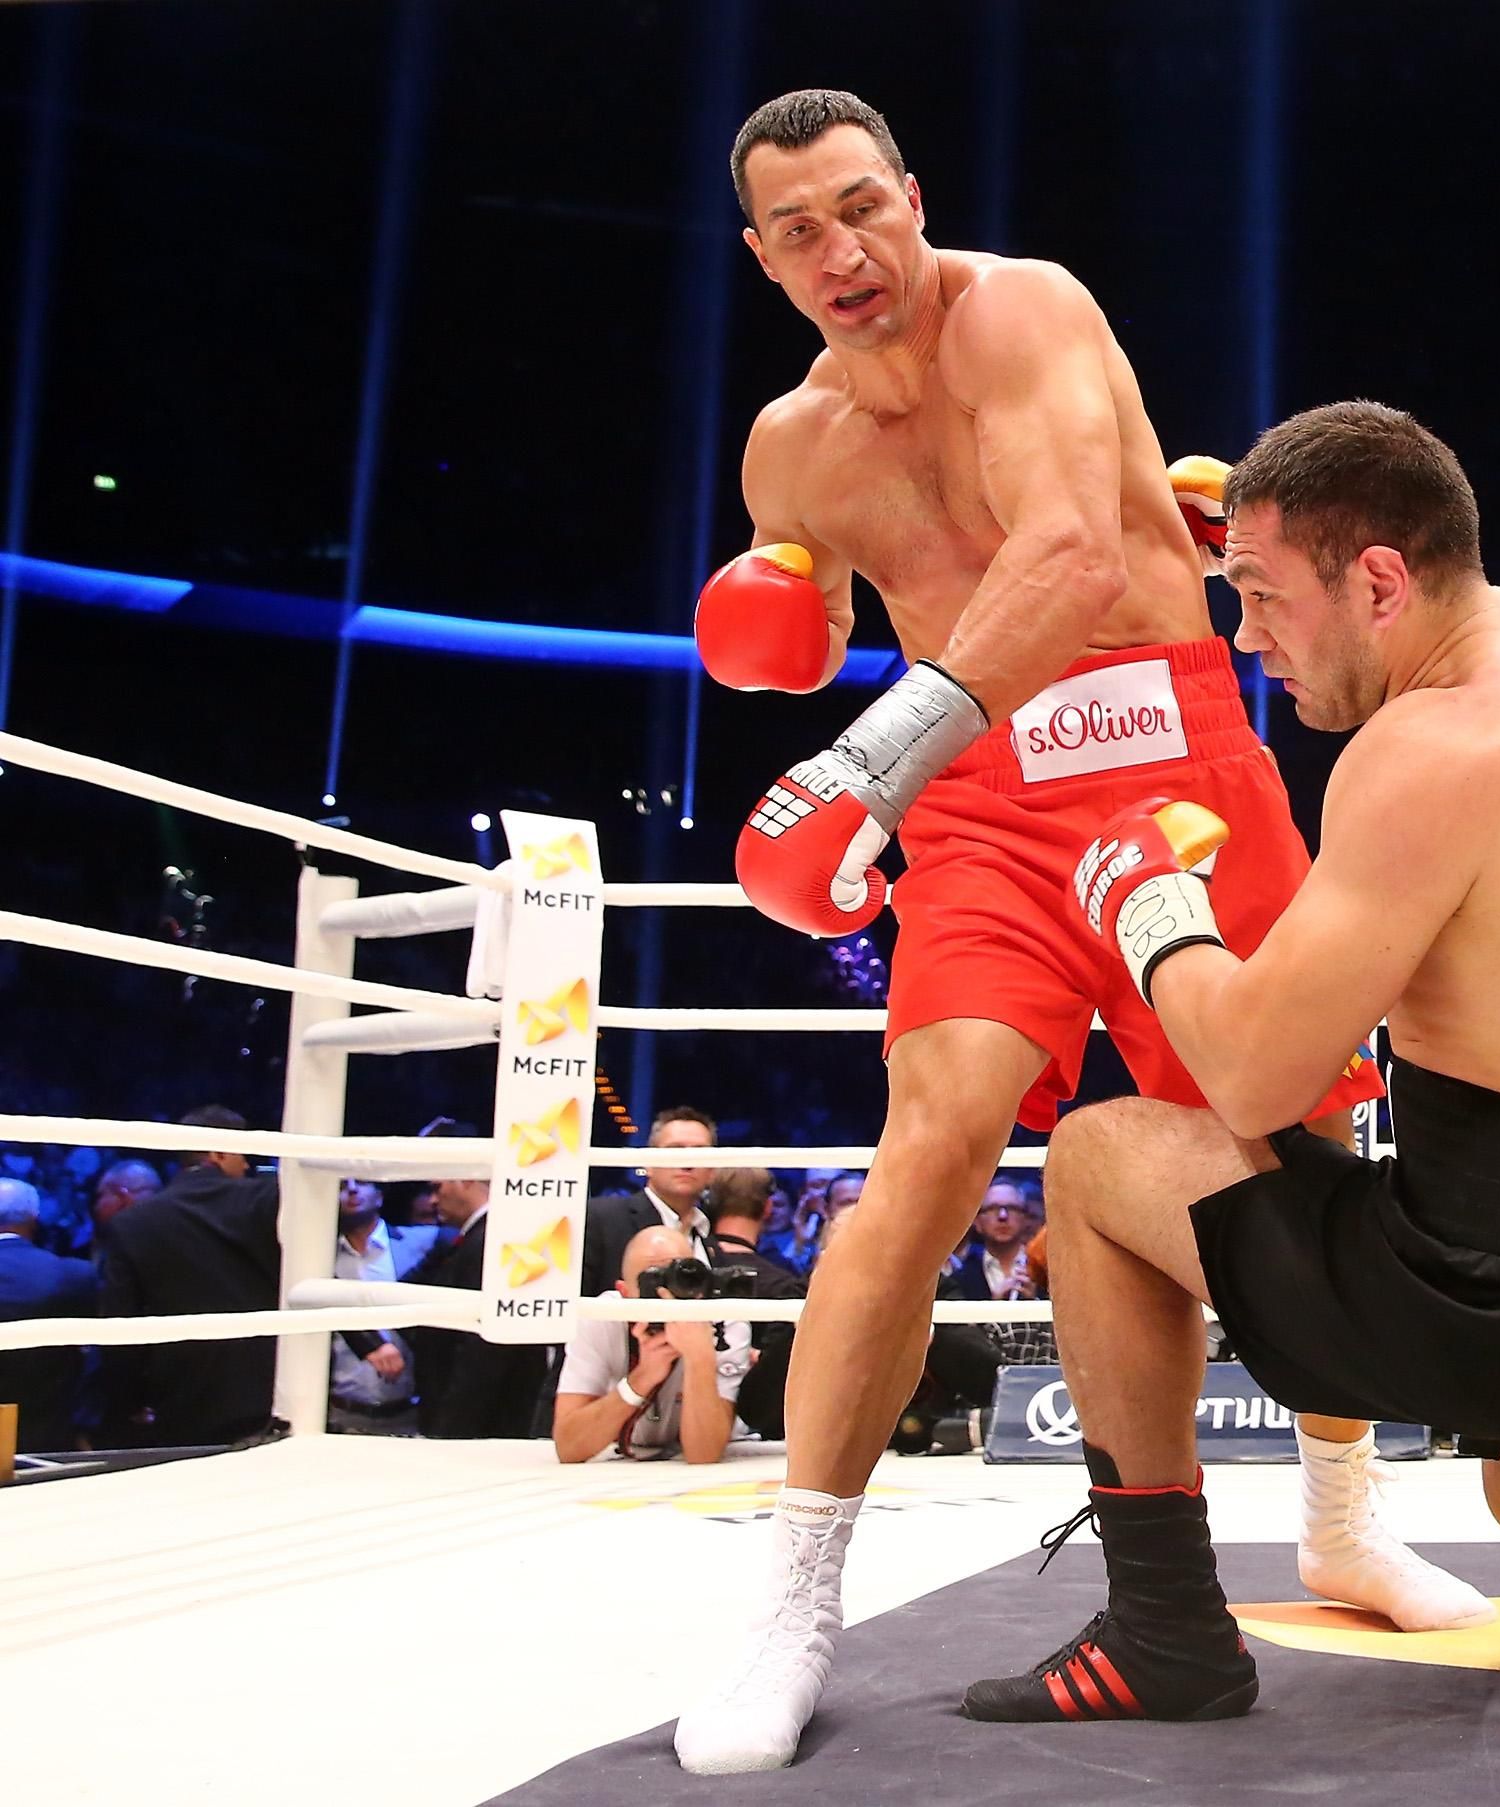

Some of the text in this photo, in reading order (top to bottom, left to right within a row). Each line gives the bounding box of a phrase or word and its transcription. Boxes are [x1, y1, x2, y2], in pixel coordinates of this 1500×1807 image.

[1028, 699, 1173, 754] s.Oliver
[524, 888, 596, 911] McFIT
[513, 1055, 588, 1078] McFIT
[505, 1178, 578, 1198] McFIT
[496, 1298, 569, 1318] McFIT
